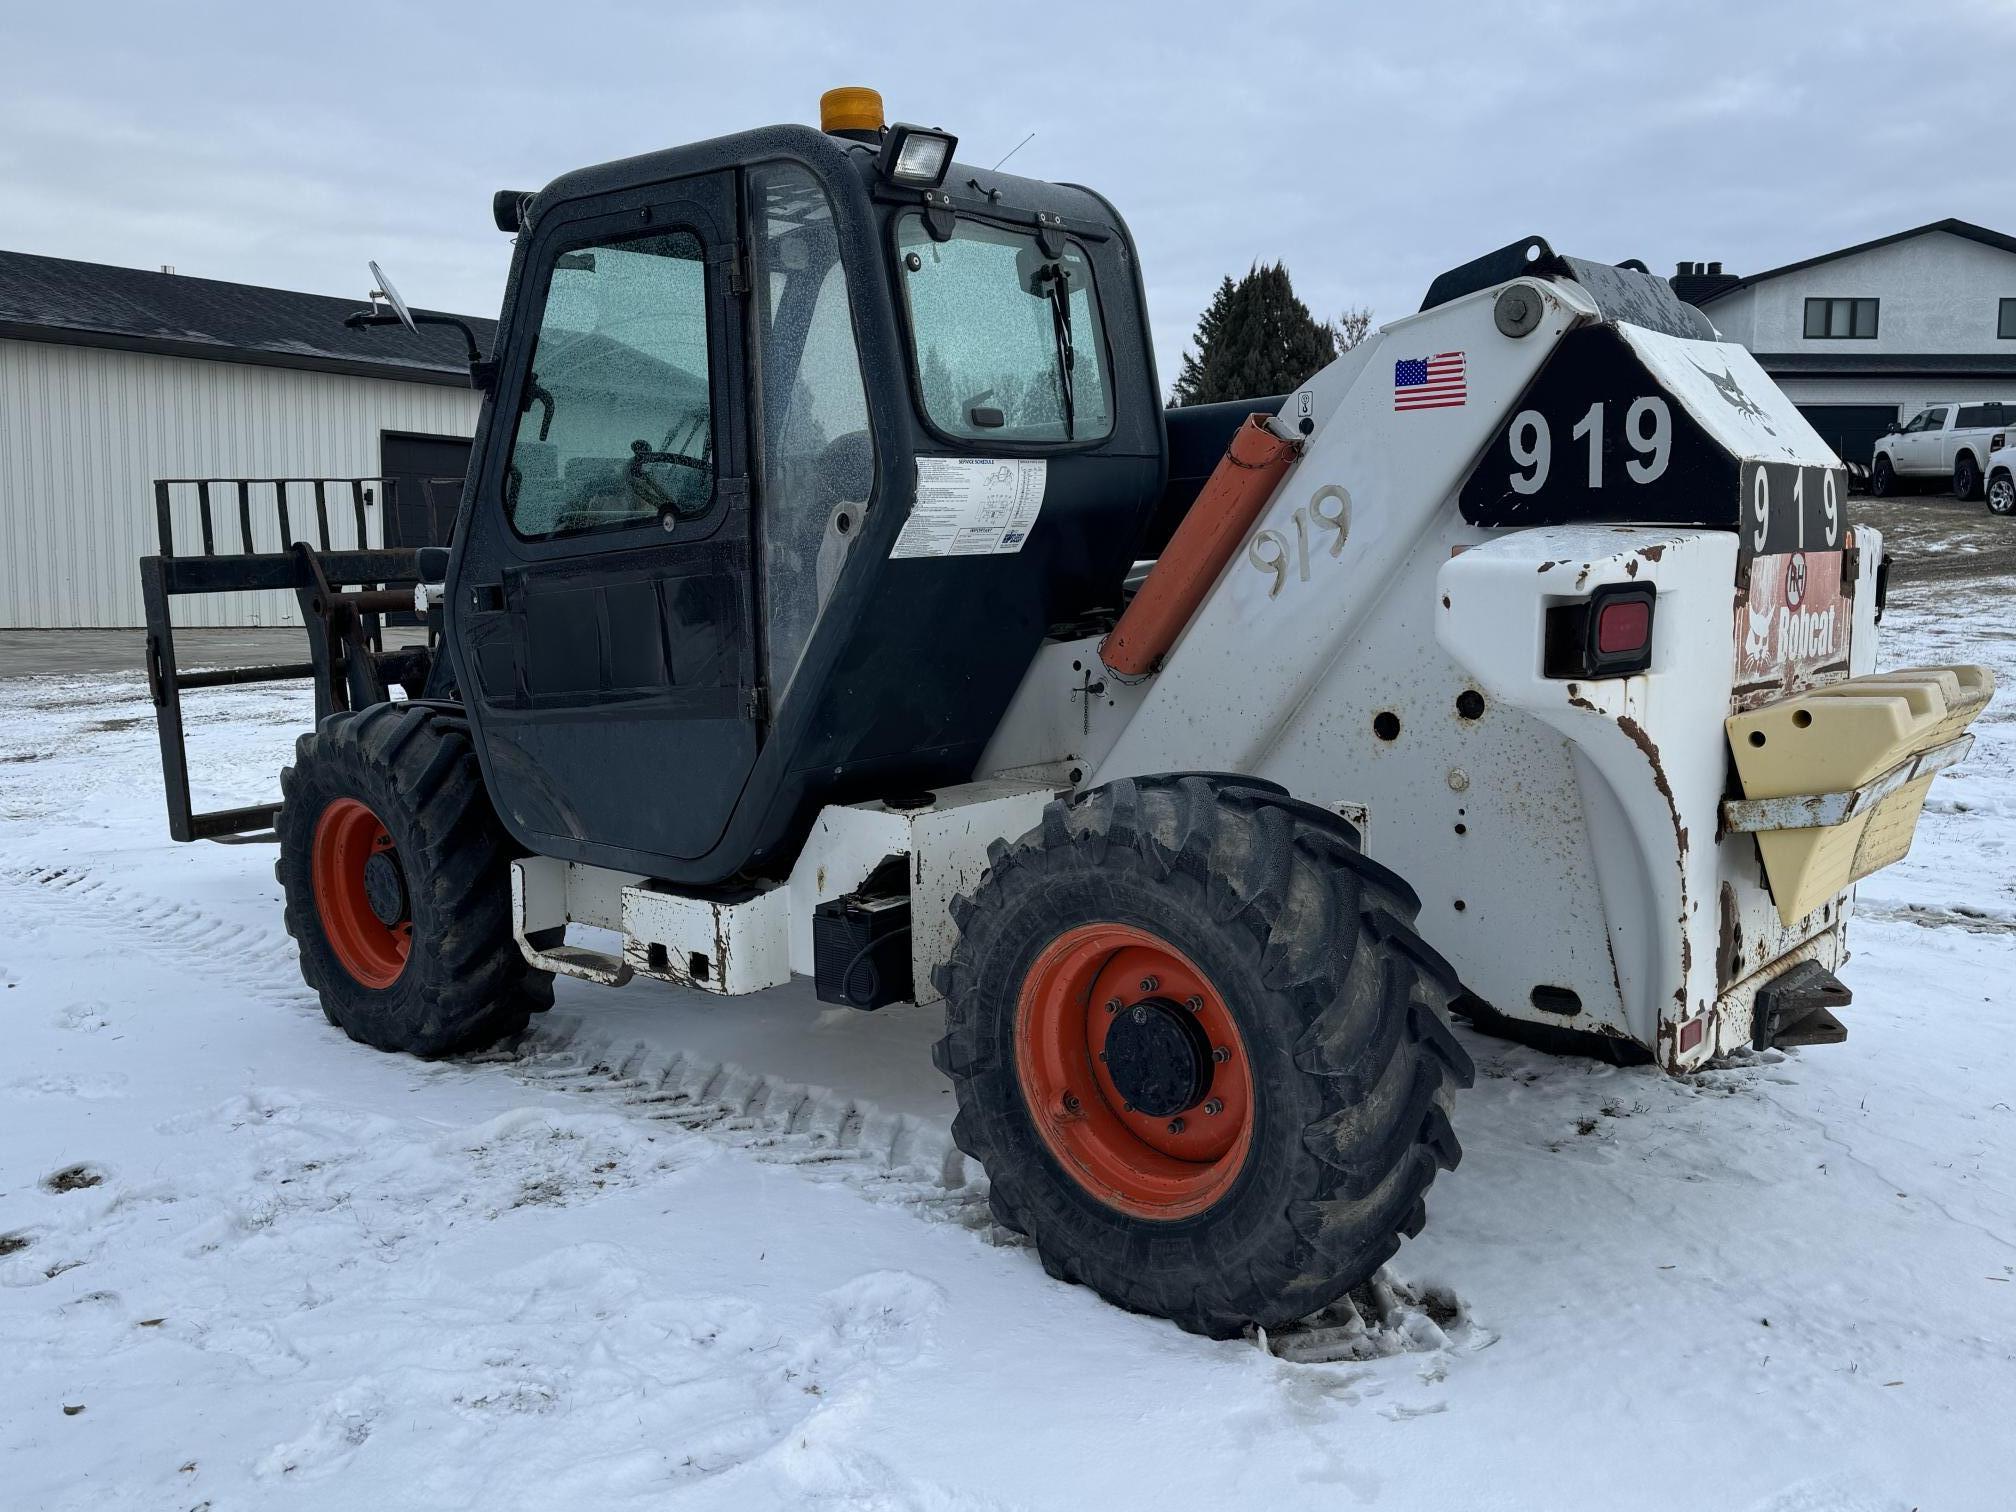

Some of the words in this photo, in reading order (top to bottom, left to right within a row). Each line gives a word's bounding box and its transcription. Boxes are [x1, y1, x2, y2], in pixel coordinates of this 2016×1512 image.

[1509, 396, 1672, 495] 919
[1249, 485, 1352, 601] 919
[1777, 604, 1836, 663] Bobcat
